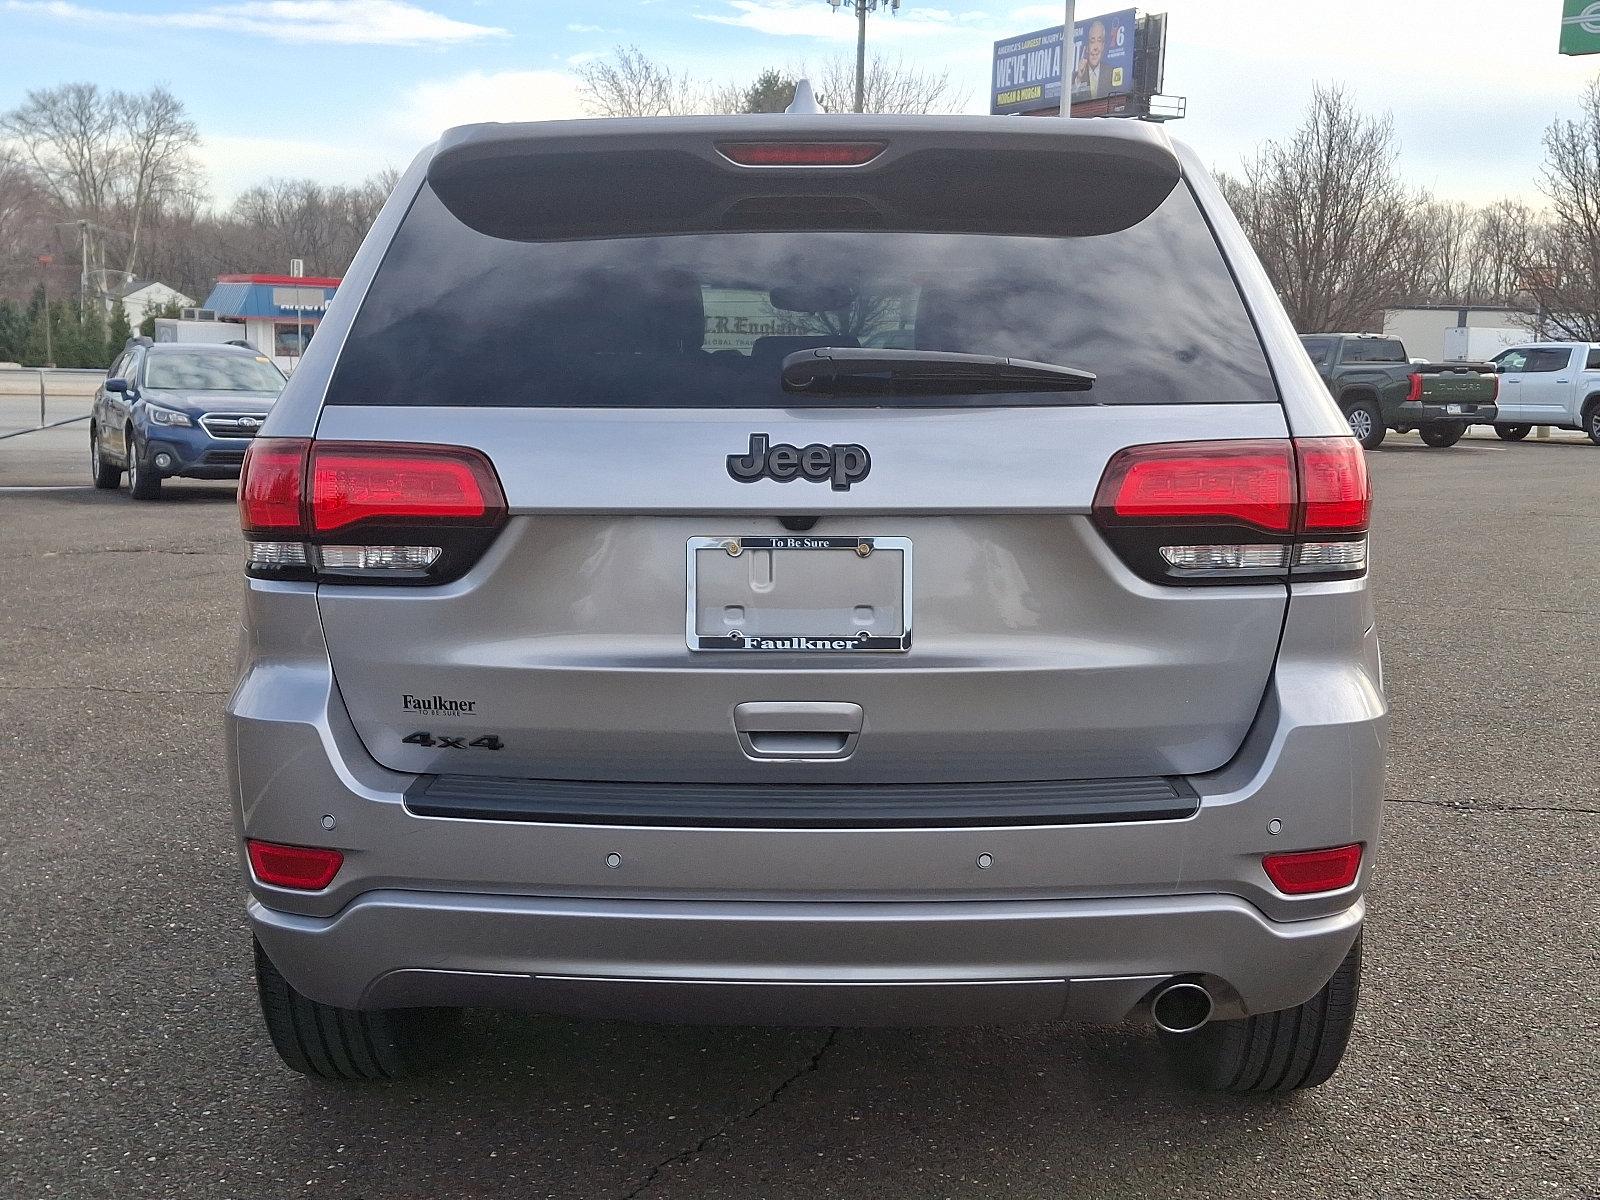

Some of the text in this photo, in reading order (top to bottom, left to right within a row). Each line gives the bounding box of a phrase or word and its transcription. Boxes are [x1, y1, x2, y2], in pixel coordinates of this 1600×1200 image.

[1021, 37, 1041, 50] LARGEST
[996, 54, 1026, 88] WE'VE
[1027, 47, 1052, 82] WON
[1052, 45, 1061, 77] A
[997, 91, 1017, 105] MORGAN
[1021, 86, 1041, 101] MORGAN
[726, 432, 871, 492] Jeep
[770, 538, 830, 547] To Be Sure
[742, 637, 859, 649] Faulkner
[402, 694, 476, 711] Faulkner
